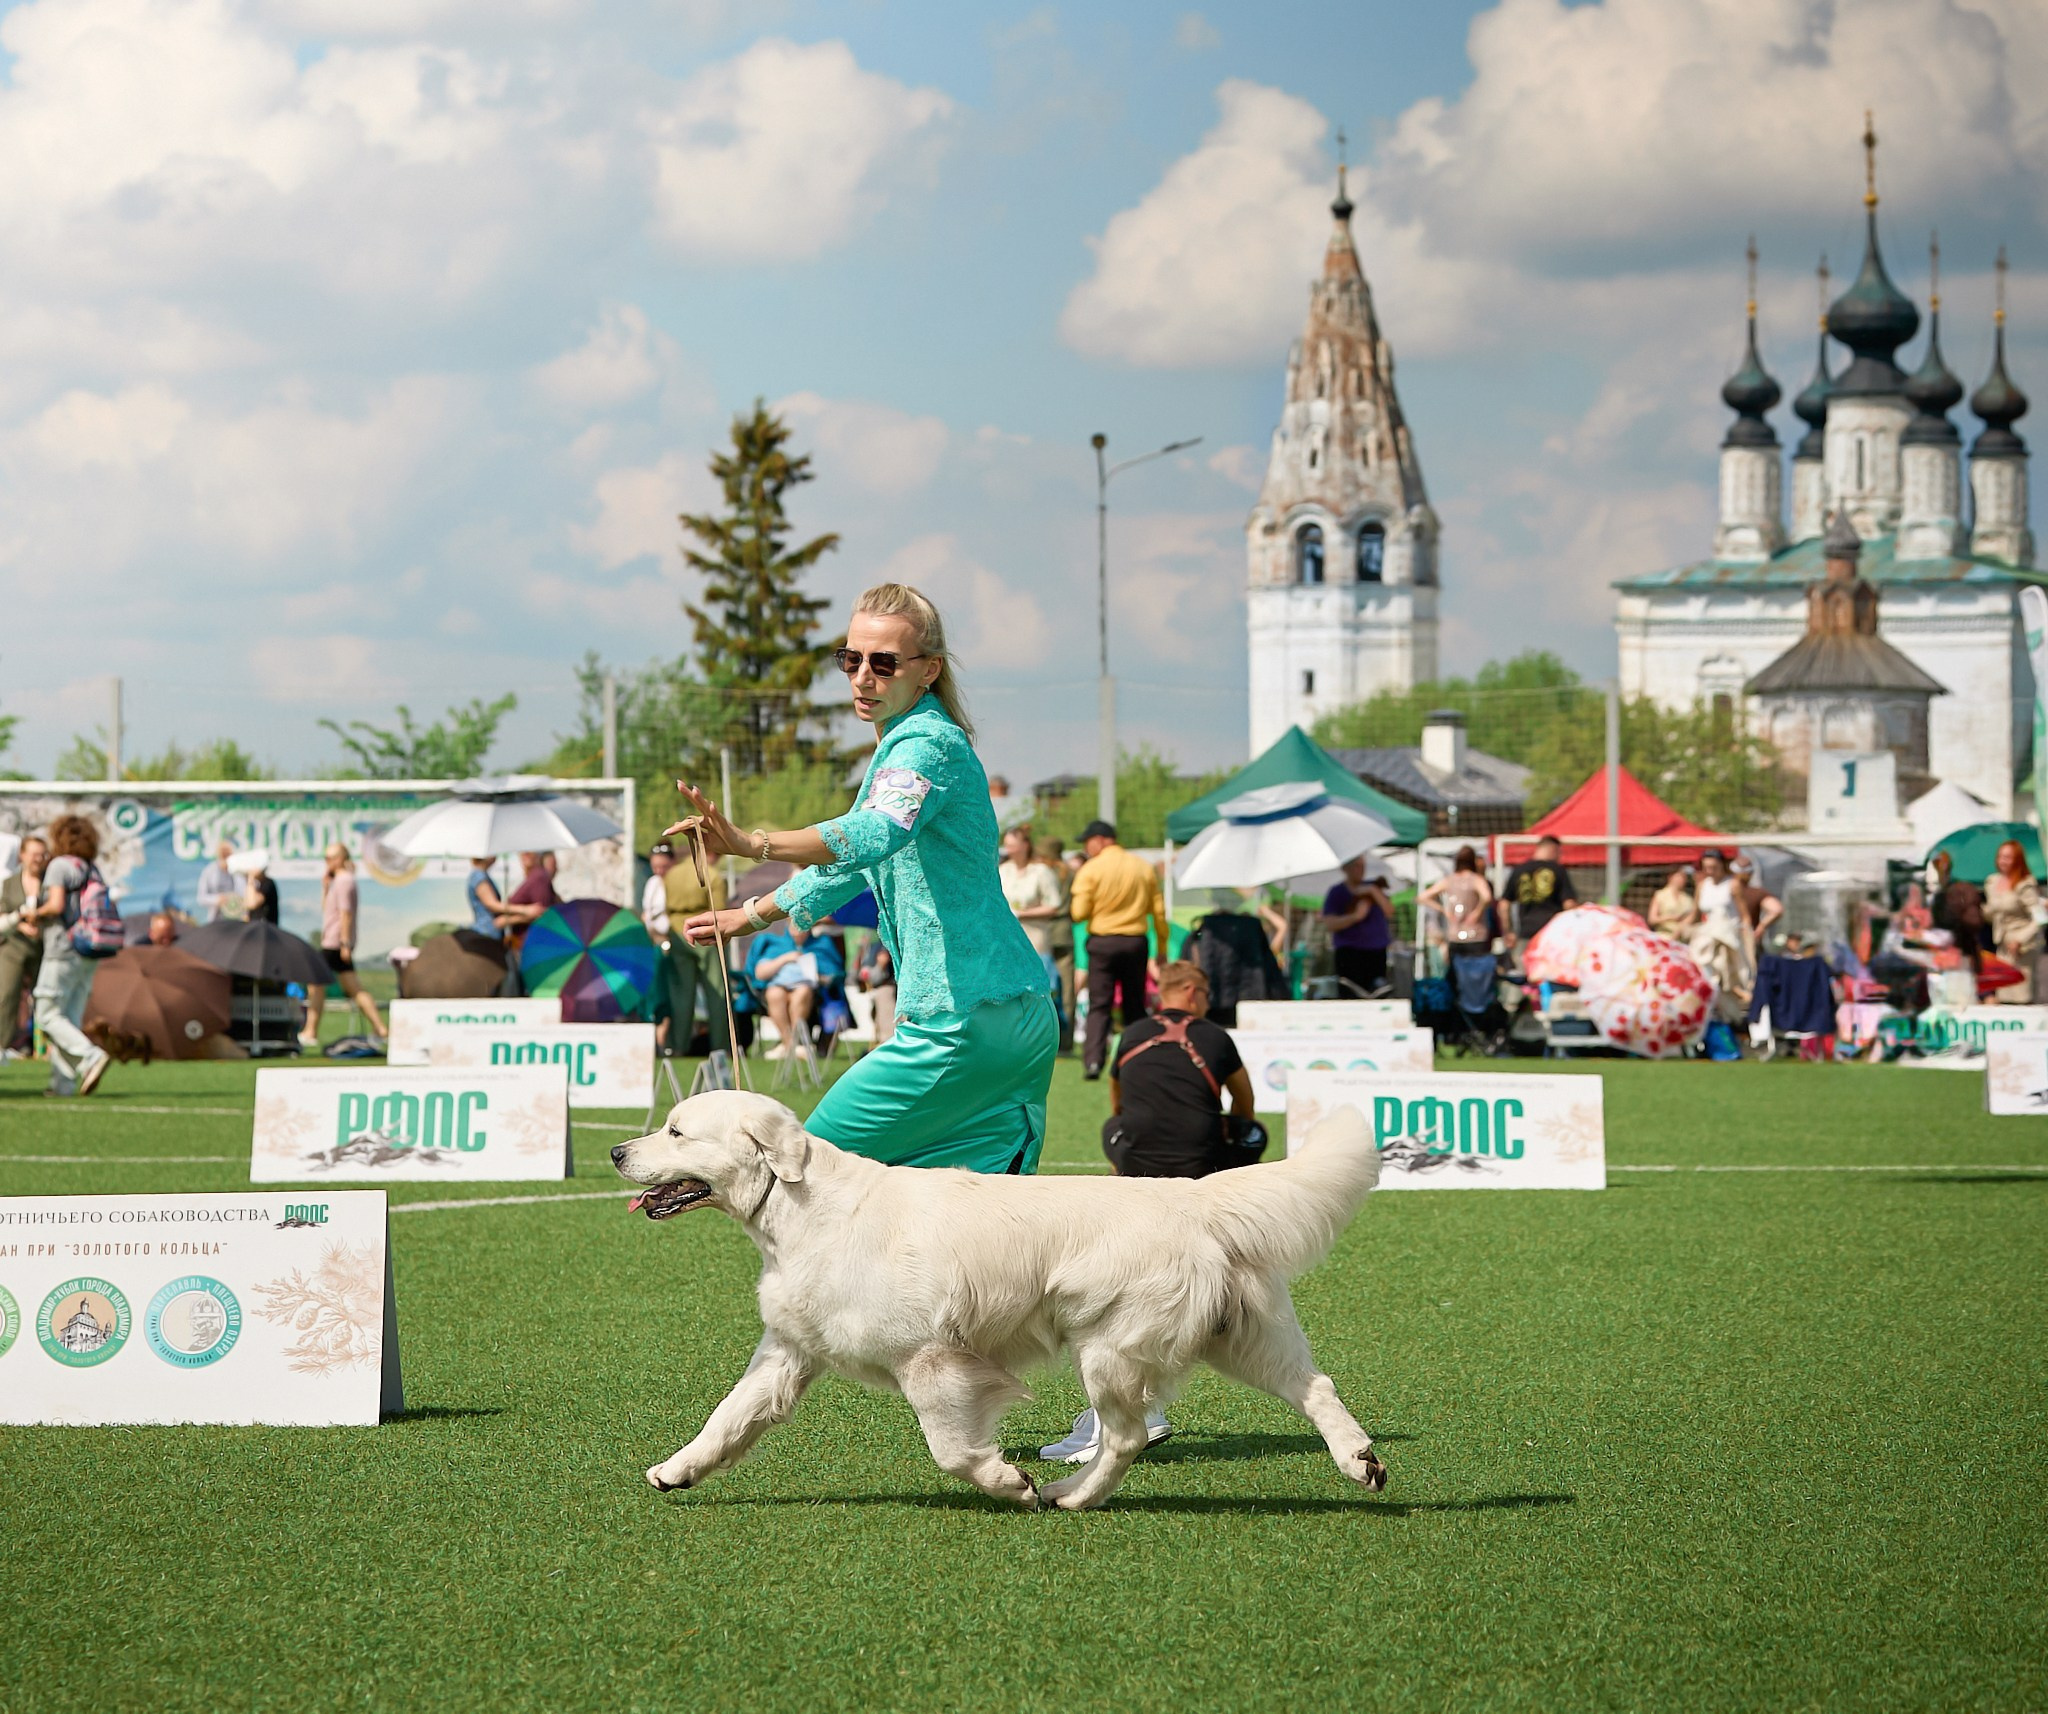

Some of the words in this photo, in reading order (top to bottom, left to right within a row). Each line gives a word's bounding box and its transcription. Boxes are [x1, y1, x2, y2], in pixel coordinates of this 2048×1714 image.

[337, 1090, 488, 1152] РФПС
[1373, 1096, 1524, 1159] РФПС
[109, 1208, 270, 1225] СОБАКОВОДСТВА
[285, 1203, 329, 1224] РФПС
[28, 1243, 55, 1257] ПРИ
[38, 1297, 57, 1342] ВЛАДИМИР
[55, 1280, 80, 1300] КУБОК
[82, 1279, 113, 1297] ГОРОДА
[110, 1291, 131, 1341] ВЛАДИМИРА
[150, 1278, 202, 1313] ПЕРЕСЛАВЛЬ
[212, 1283, 240, 1326] ПЛЕЩЕЕВО
[215, 1329, 238, 1356] ОЗЕРО
